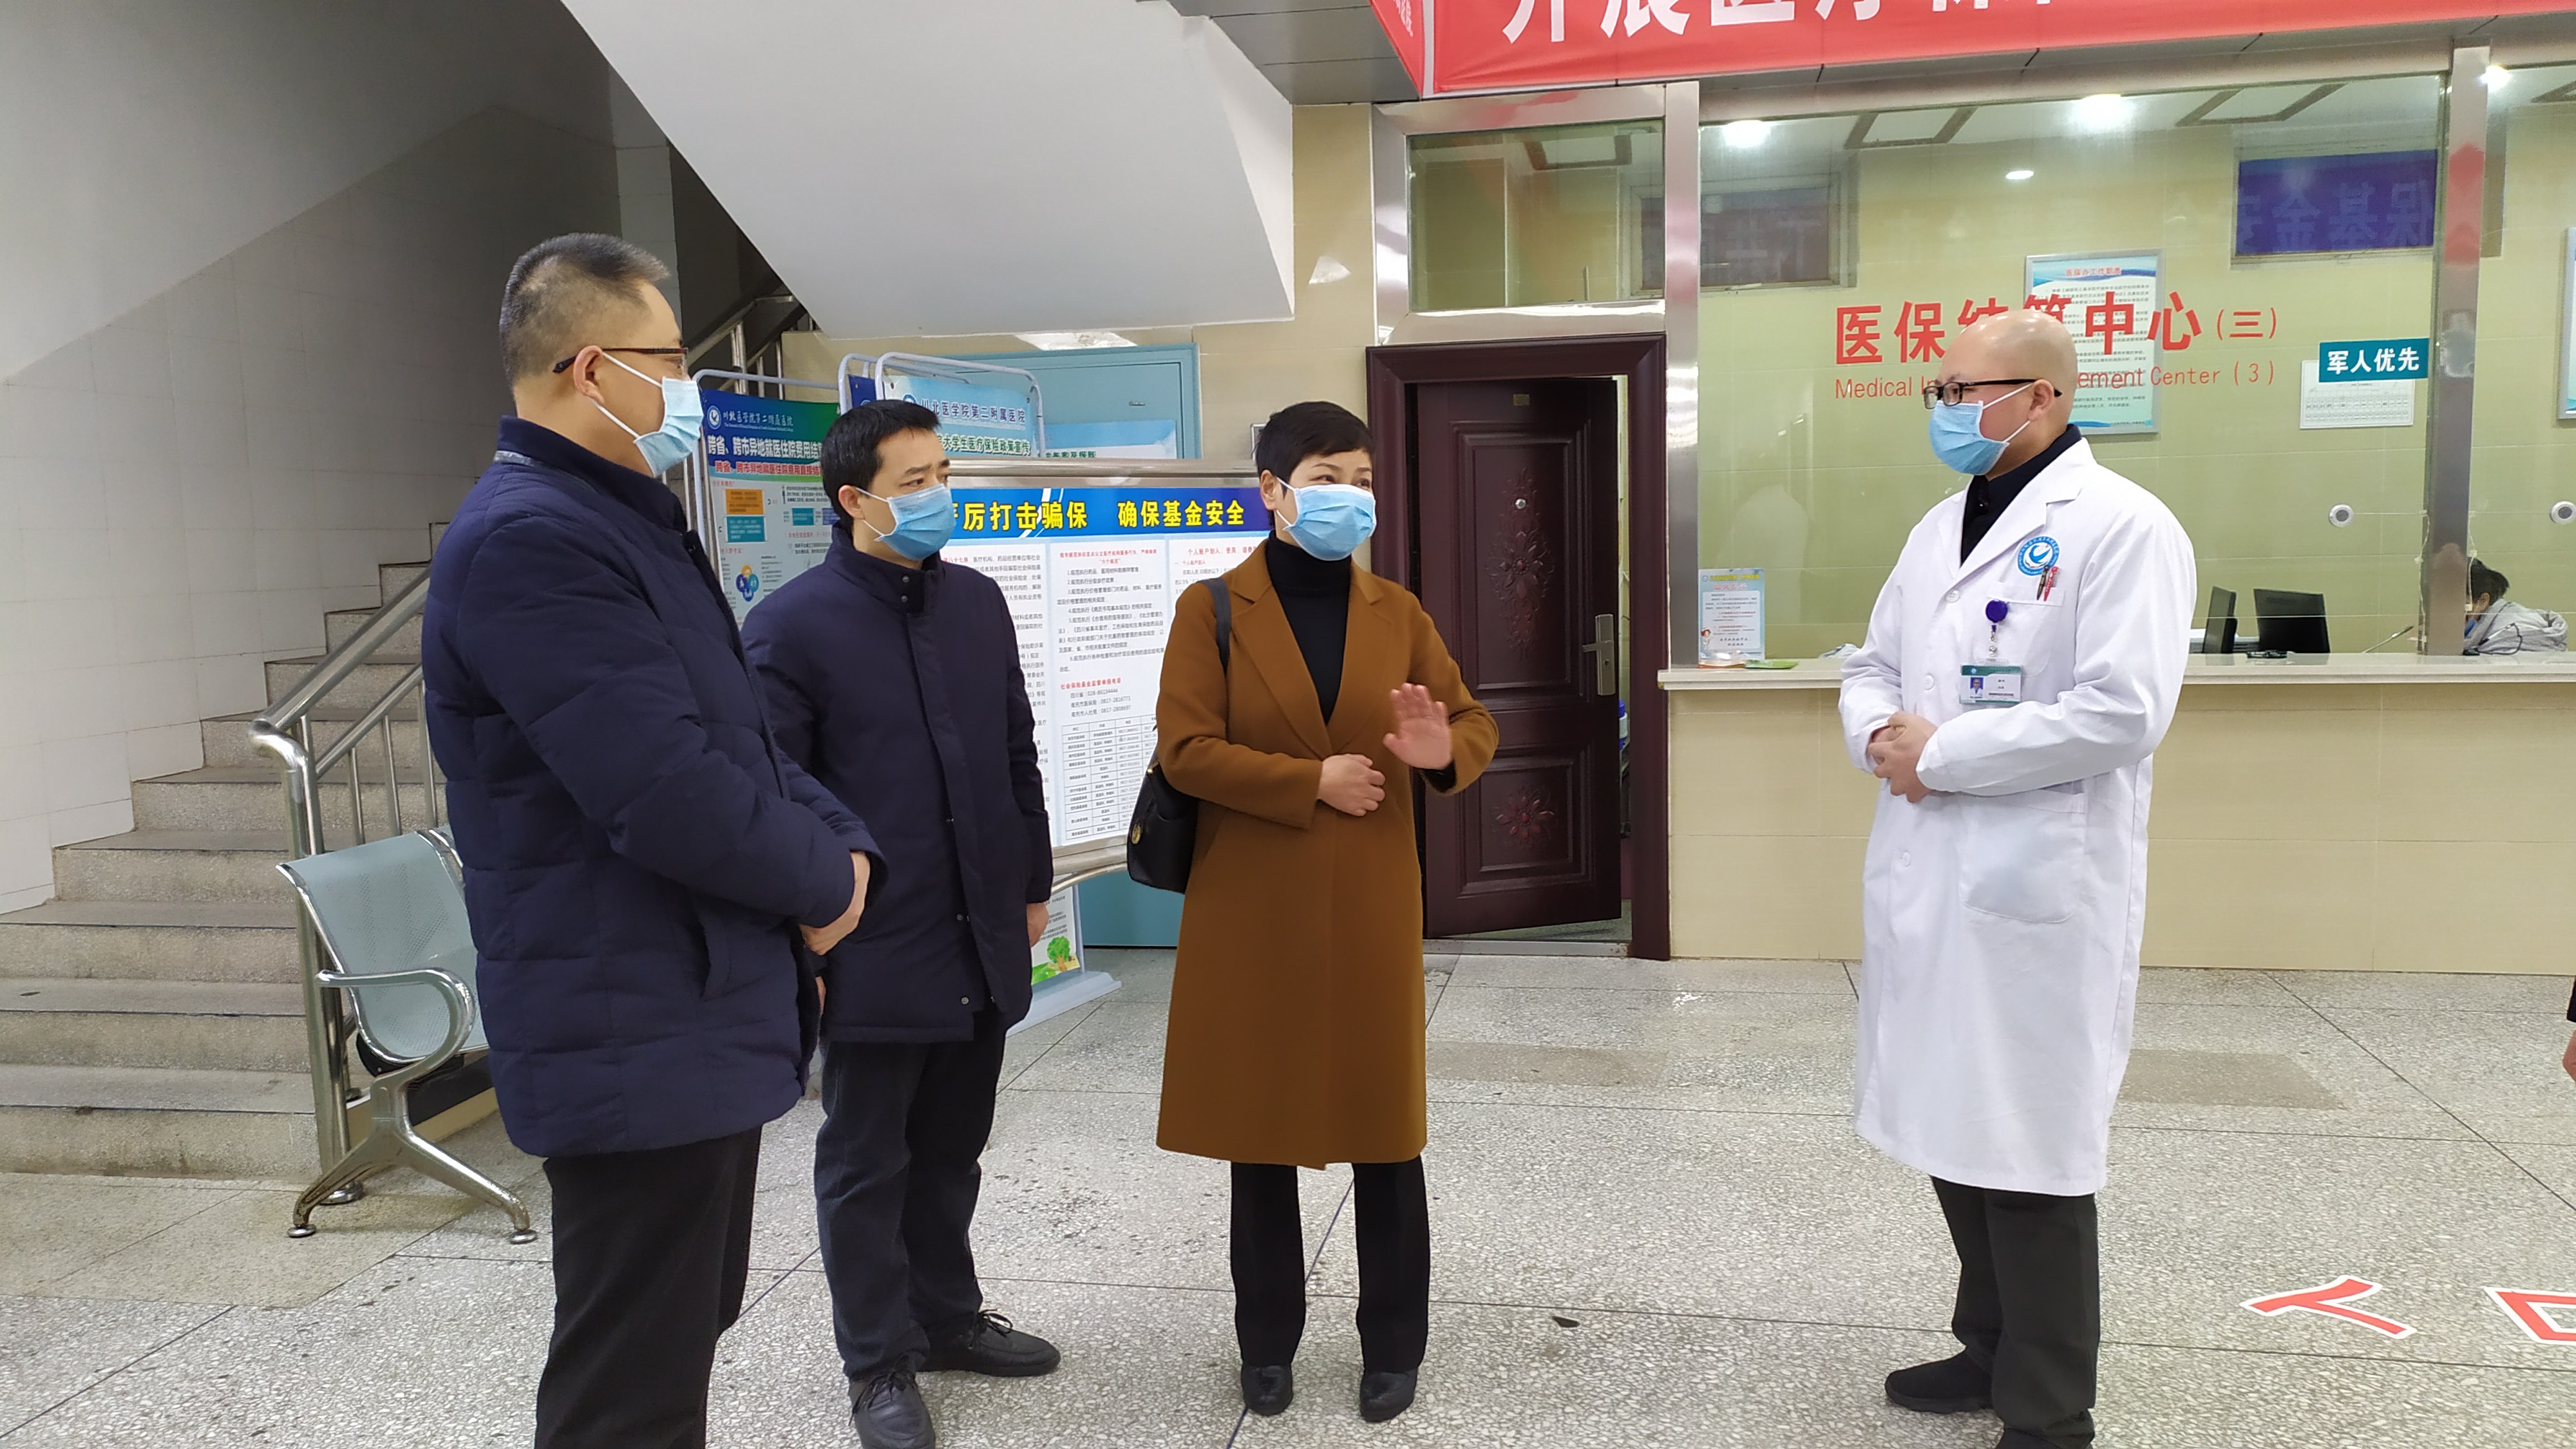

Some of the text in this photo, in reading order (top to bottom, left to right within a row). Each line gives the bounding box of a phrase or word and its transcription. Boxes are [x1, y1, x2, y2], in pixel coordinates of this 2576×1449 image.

[2327, 346, 2420, 374] 军人优先
[1835, 377, 1912, 399] Medical
[2077, 366, 2143, 389] ement
[2151, 365, 2221, 386] Center
[1117, 499, 1245, 527] 确保基金安全
